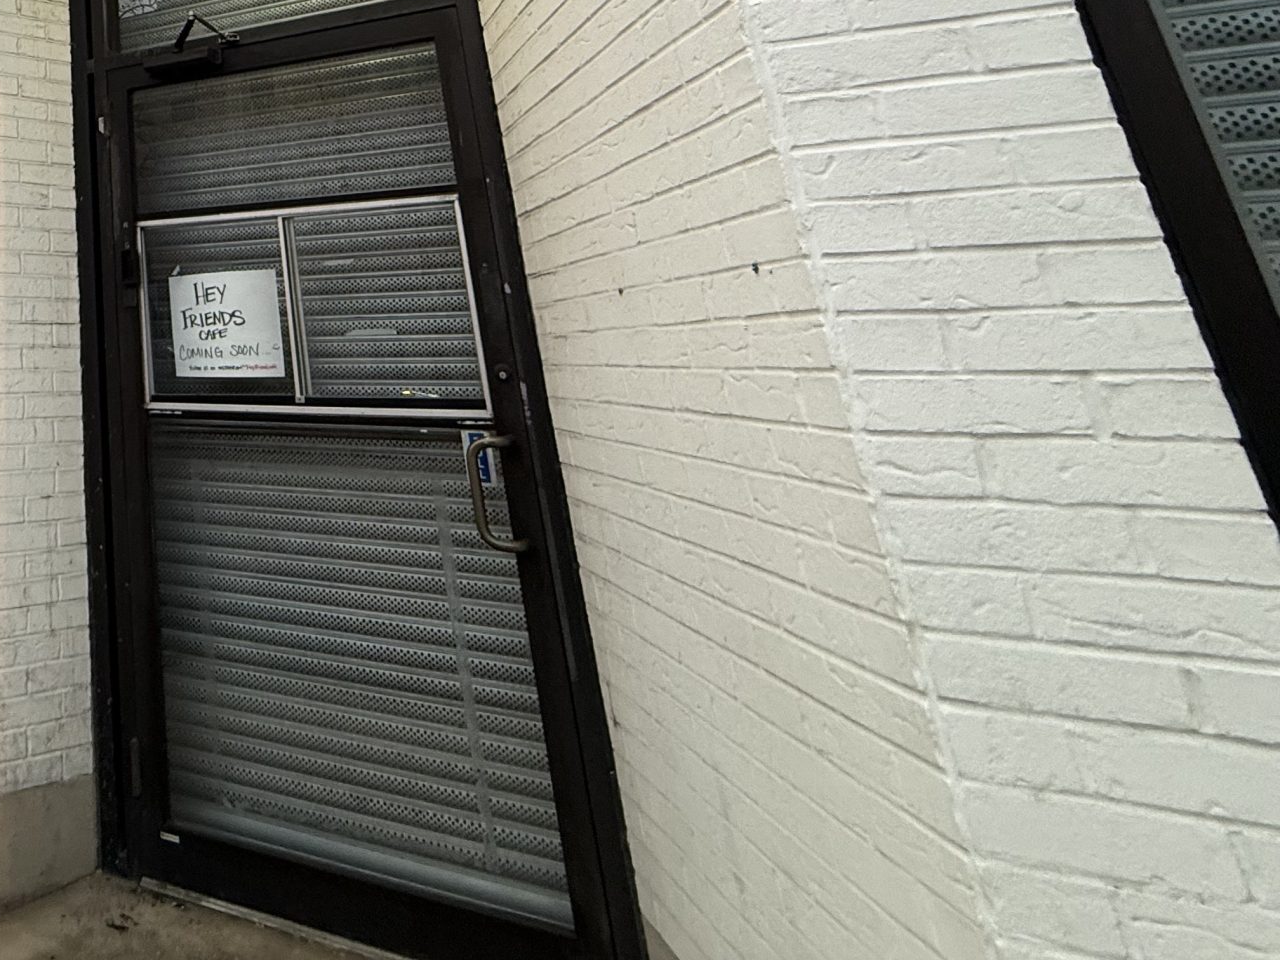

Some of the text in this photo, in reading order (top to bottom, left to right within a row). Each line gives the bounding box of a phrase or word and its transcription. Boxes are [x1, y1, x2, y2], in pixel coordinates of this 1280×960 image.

[193, 281, 227, 306] HEY
[181, 307, 246, 330] FRIENDS
[198, 327, 228, 341] CAFE
[179, 343, 224, 361] COMING
